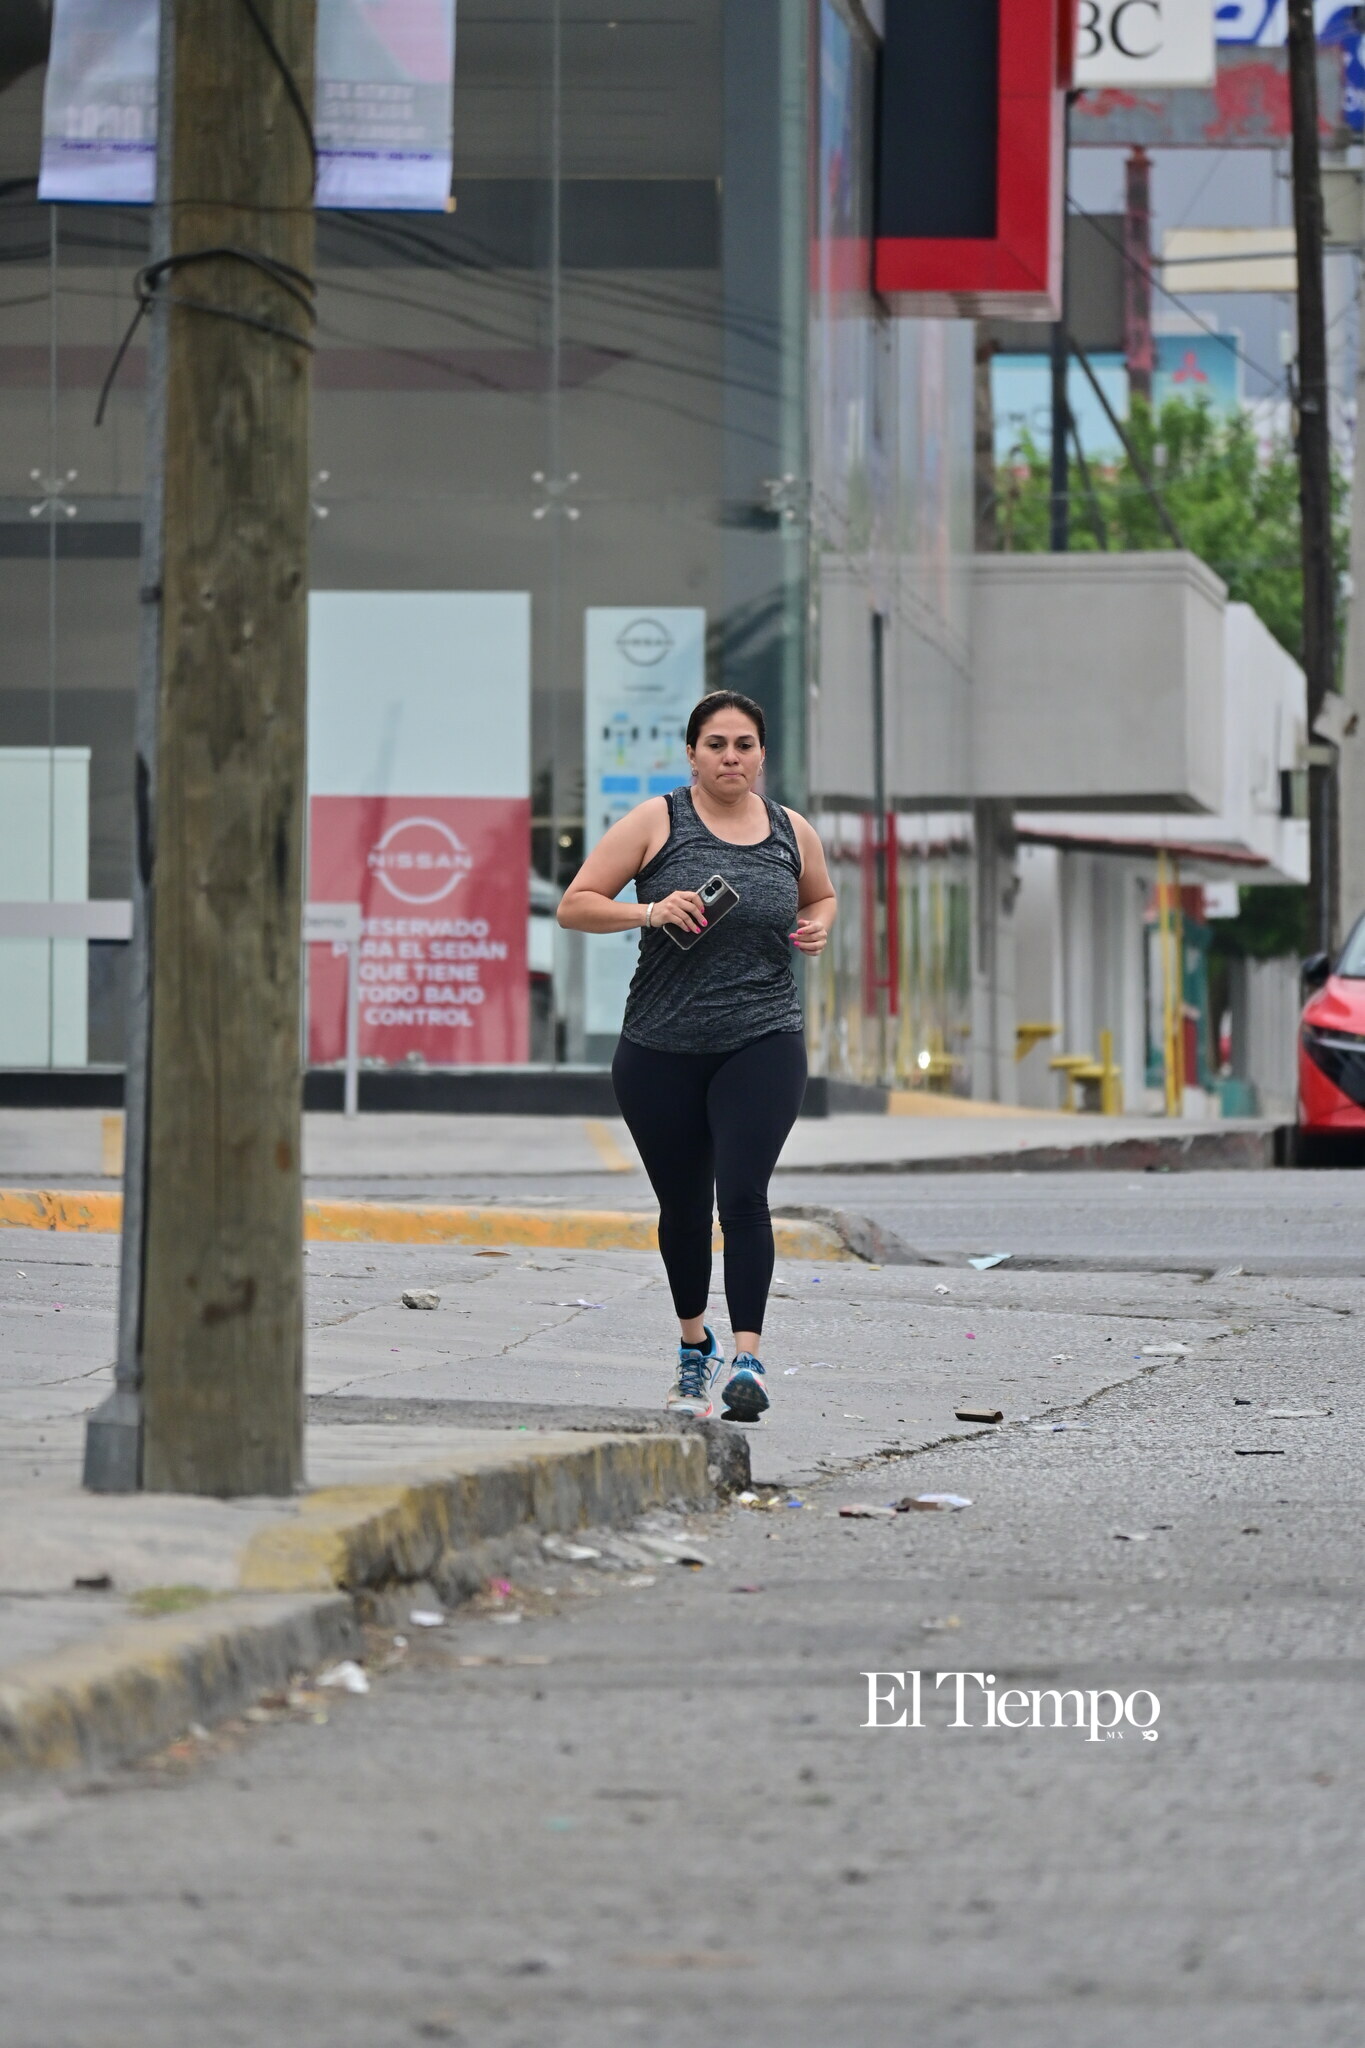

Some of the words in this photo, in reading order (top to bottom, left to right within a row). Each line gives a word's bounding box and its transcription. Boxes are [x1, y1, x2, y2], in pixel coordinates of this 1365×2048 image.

[368, 852, 473, 870] NISSAN
[331, 940, 393, 958] PRA
[398, 941, 424, 960] EL
[429, 937, 508, 961] SEDÁN
[358, 963, 408, 982] QUE
[413, 963, 479, 983] TIENE
[359, 985, 419, 1004] TODO
[423, 985, 485, 1005] BAJO
[364, 1007, 474, 1028] CONTROL
